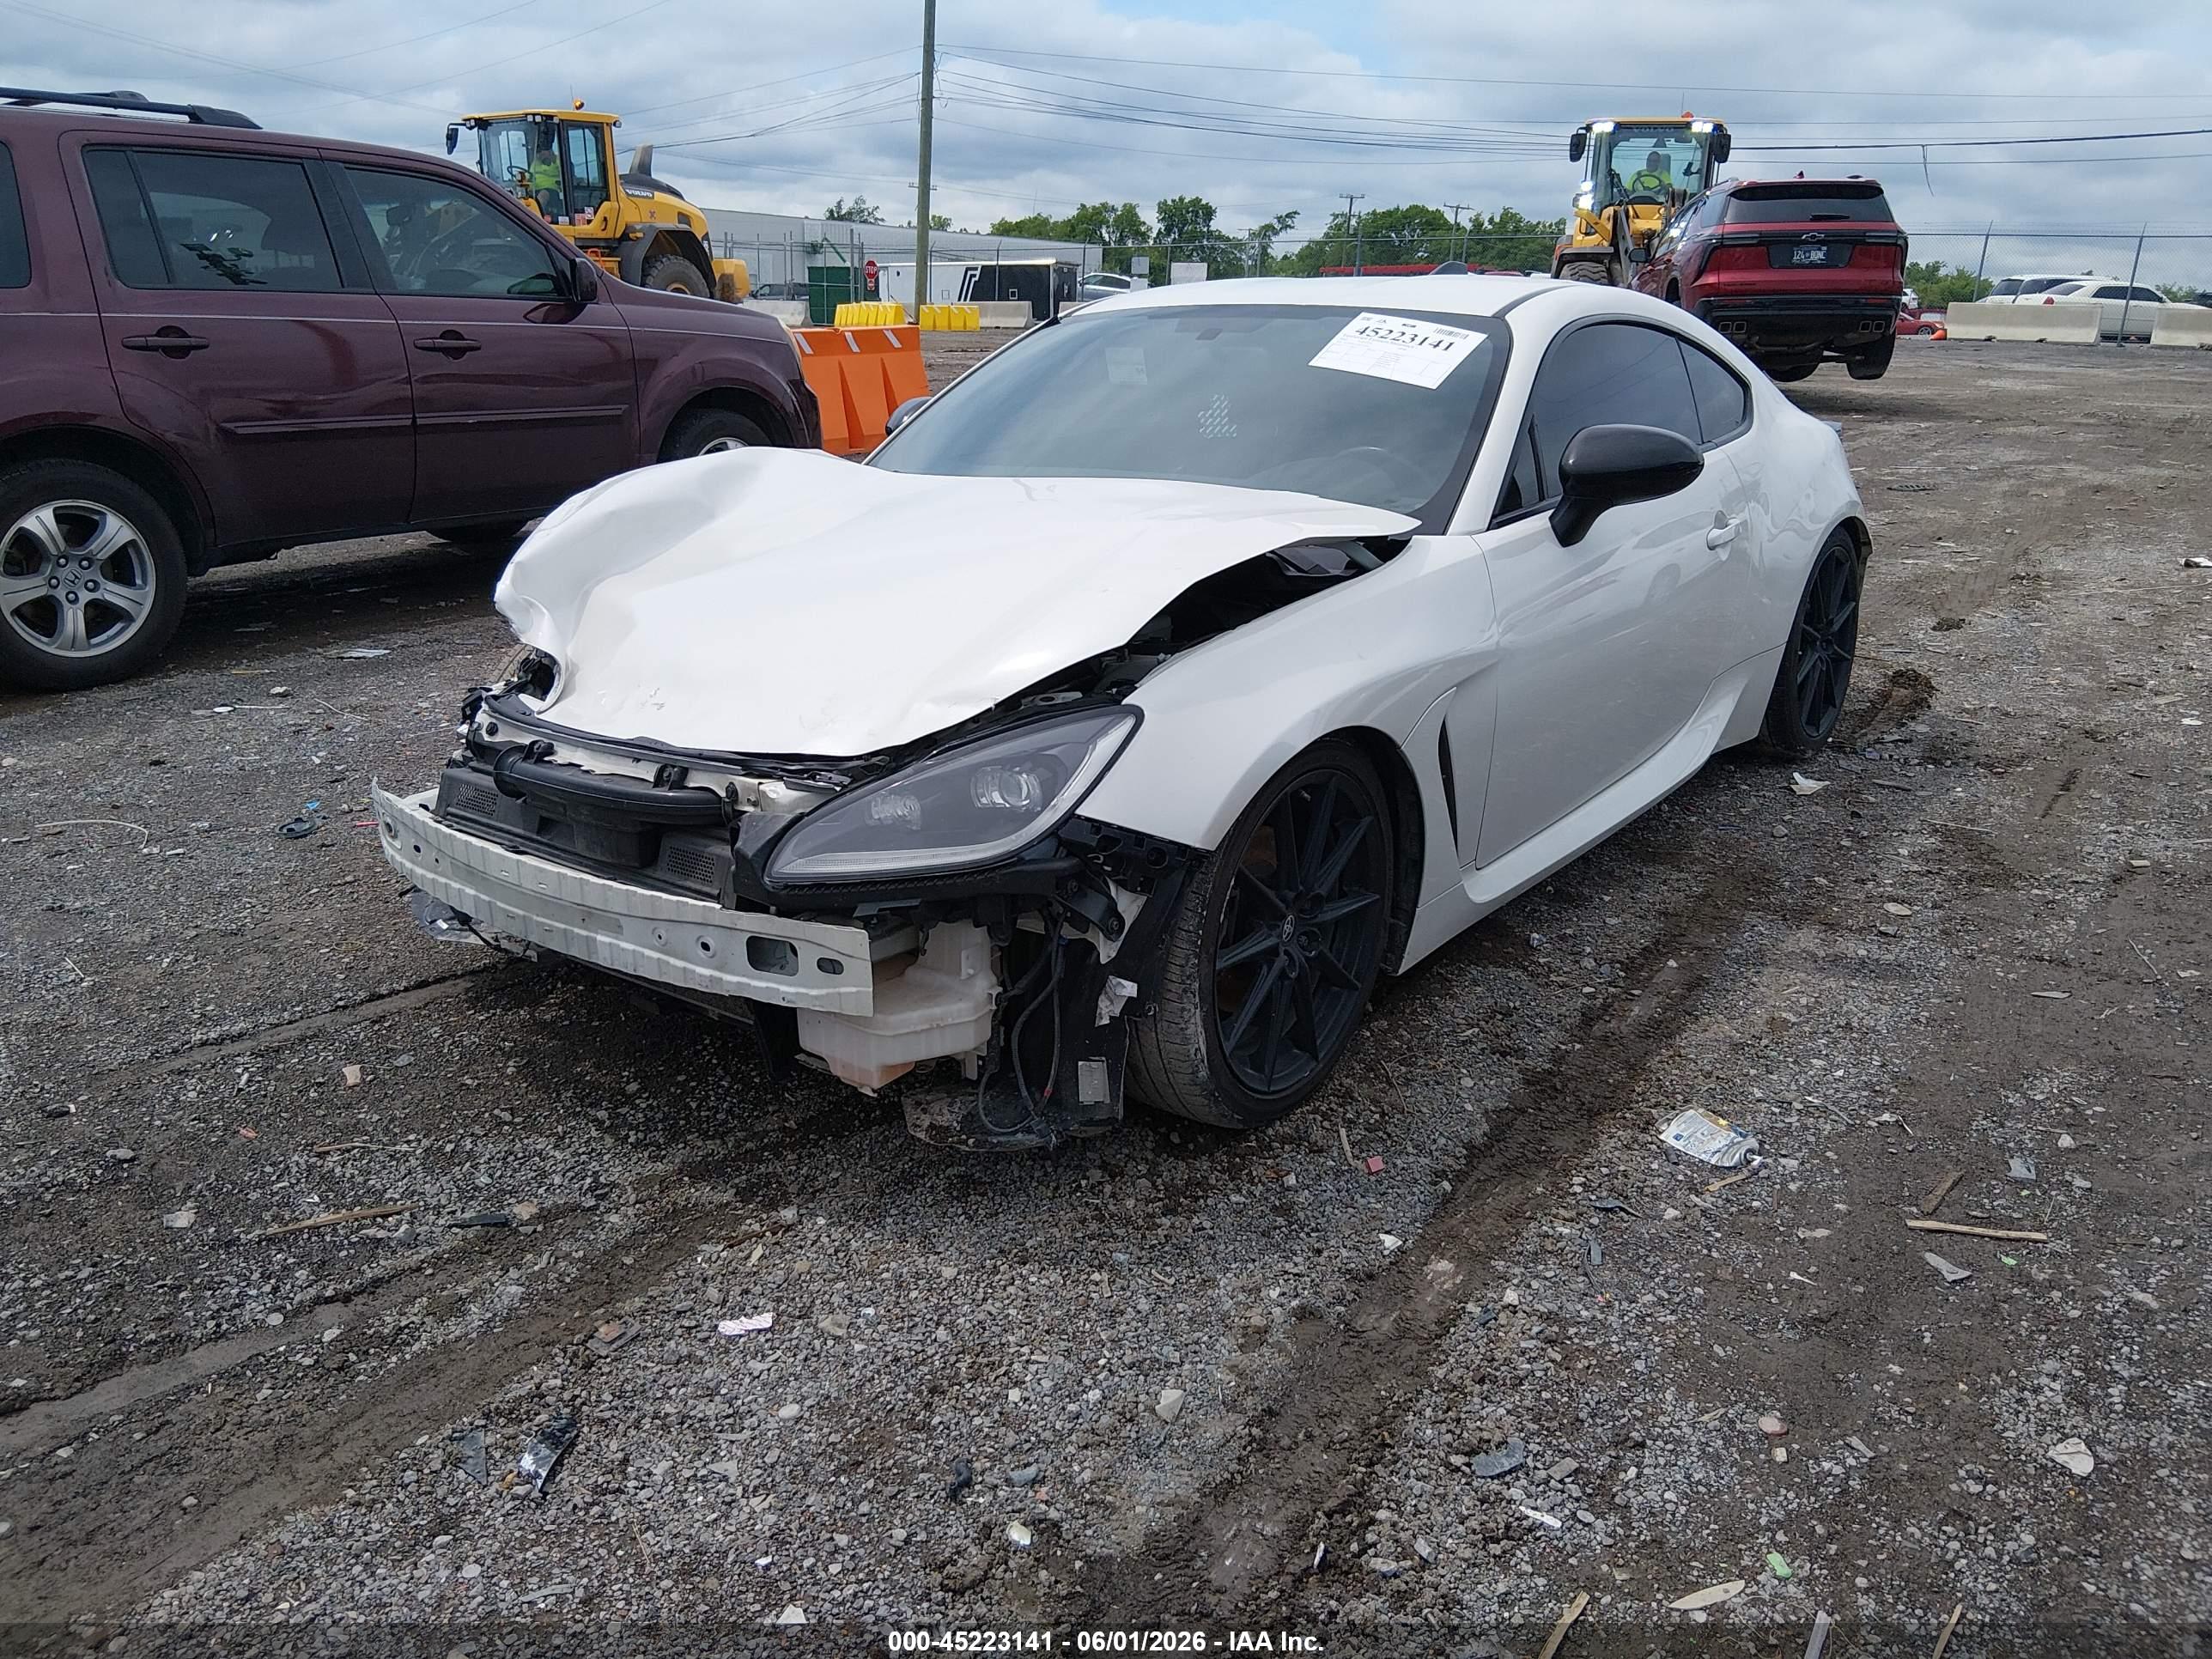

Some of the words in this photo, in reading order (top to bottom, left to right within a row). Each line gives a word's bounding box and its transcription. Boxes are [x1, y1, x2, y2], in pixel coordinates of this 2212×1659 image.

[626, 189, 653, 198] VOLVO
[865, 265, 878, 275] STOP
[1355, 325, 1456, 352] 45223141
